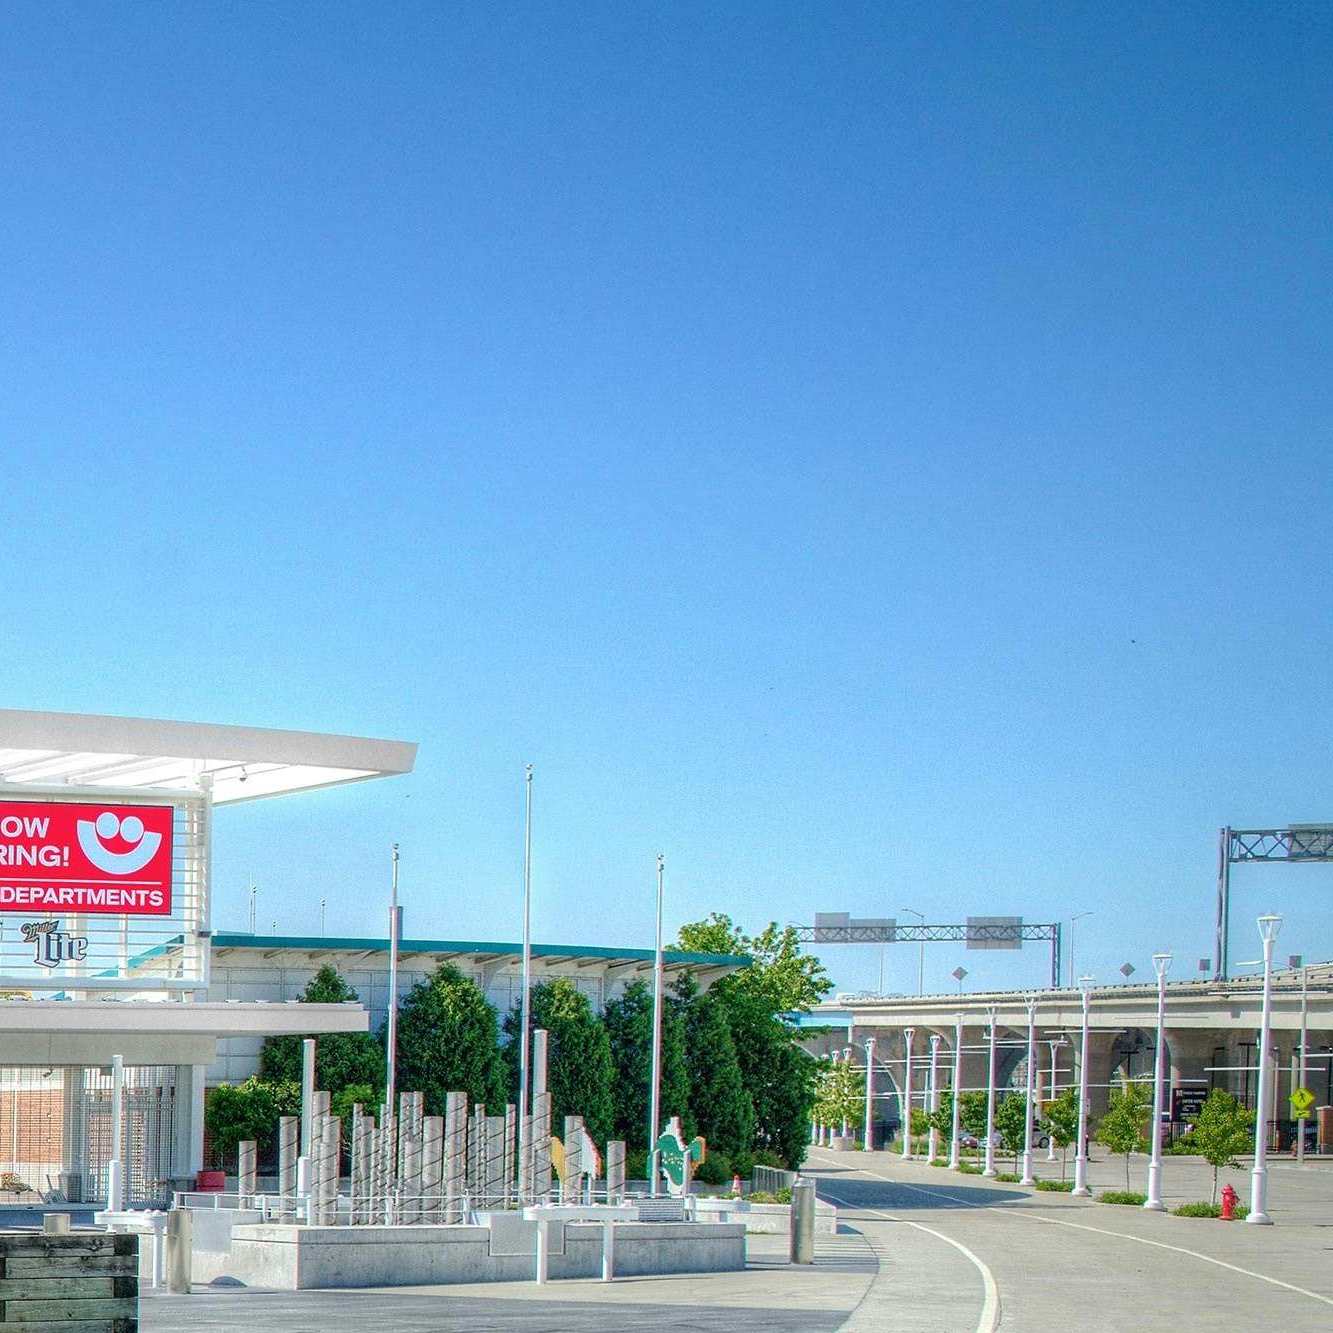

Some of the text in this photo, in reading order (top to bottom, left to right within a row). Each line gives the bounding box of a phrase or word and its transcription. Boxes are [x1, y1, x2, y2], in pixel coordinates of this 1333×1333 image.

[0, 888, 163, 906] DEPARTMENTS
[21, 920, 59, 943] Miller
[34, 931, 88, 968] Lite
